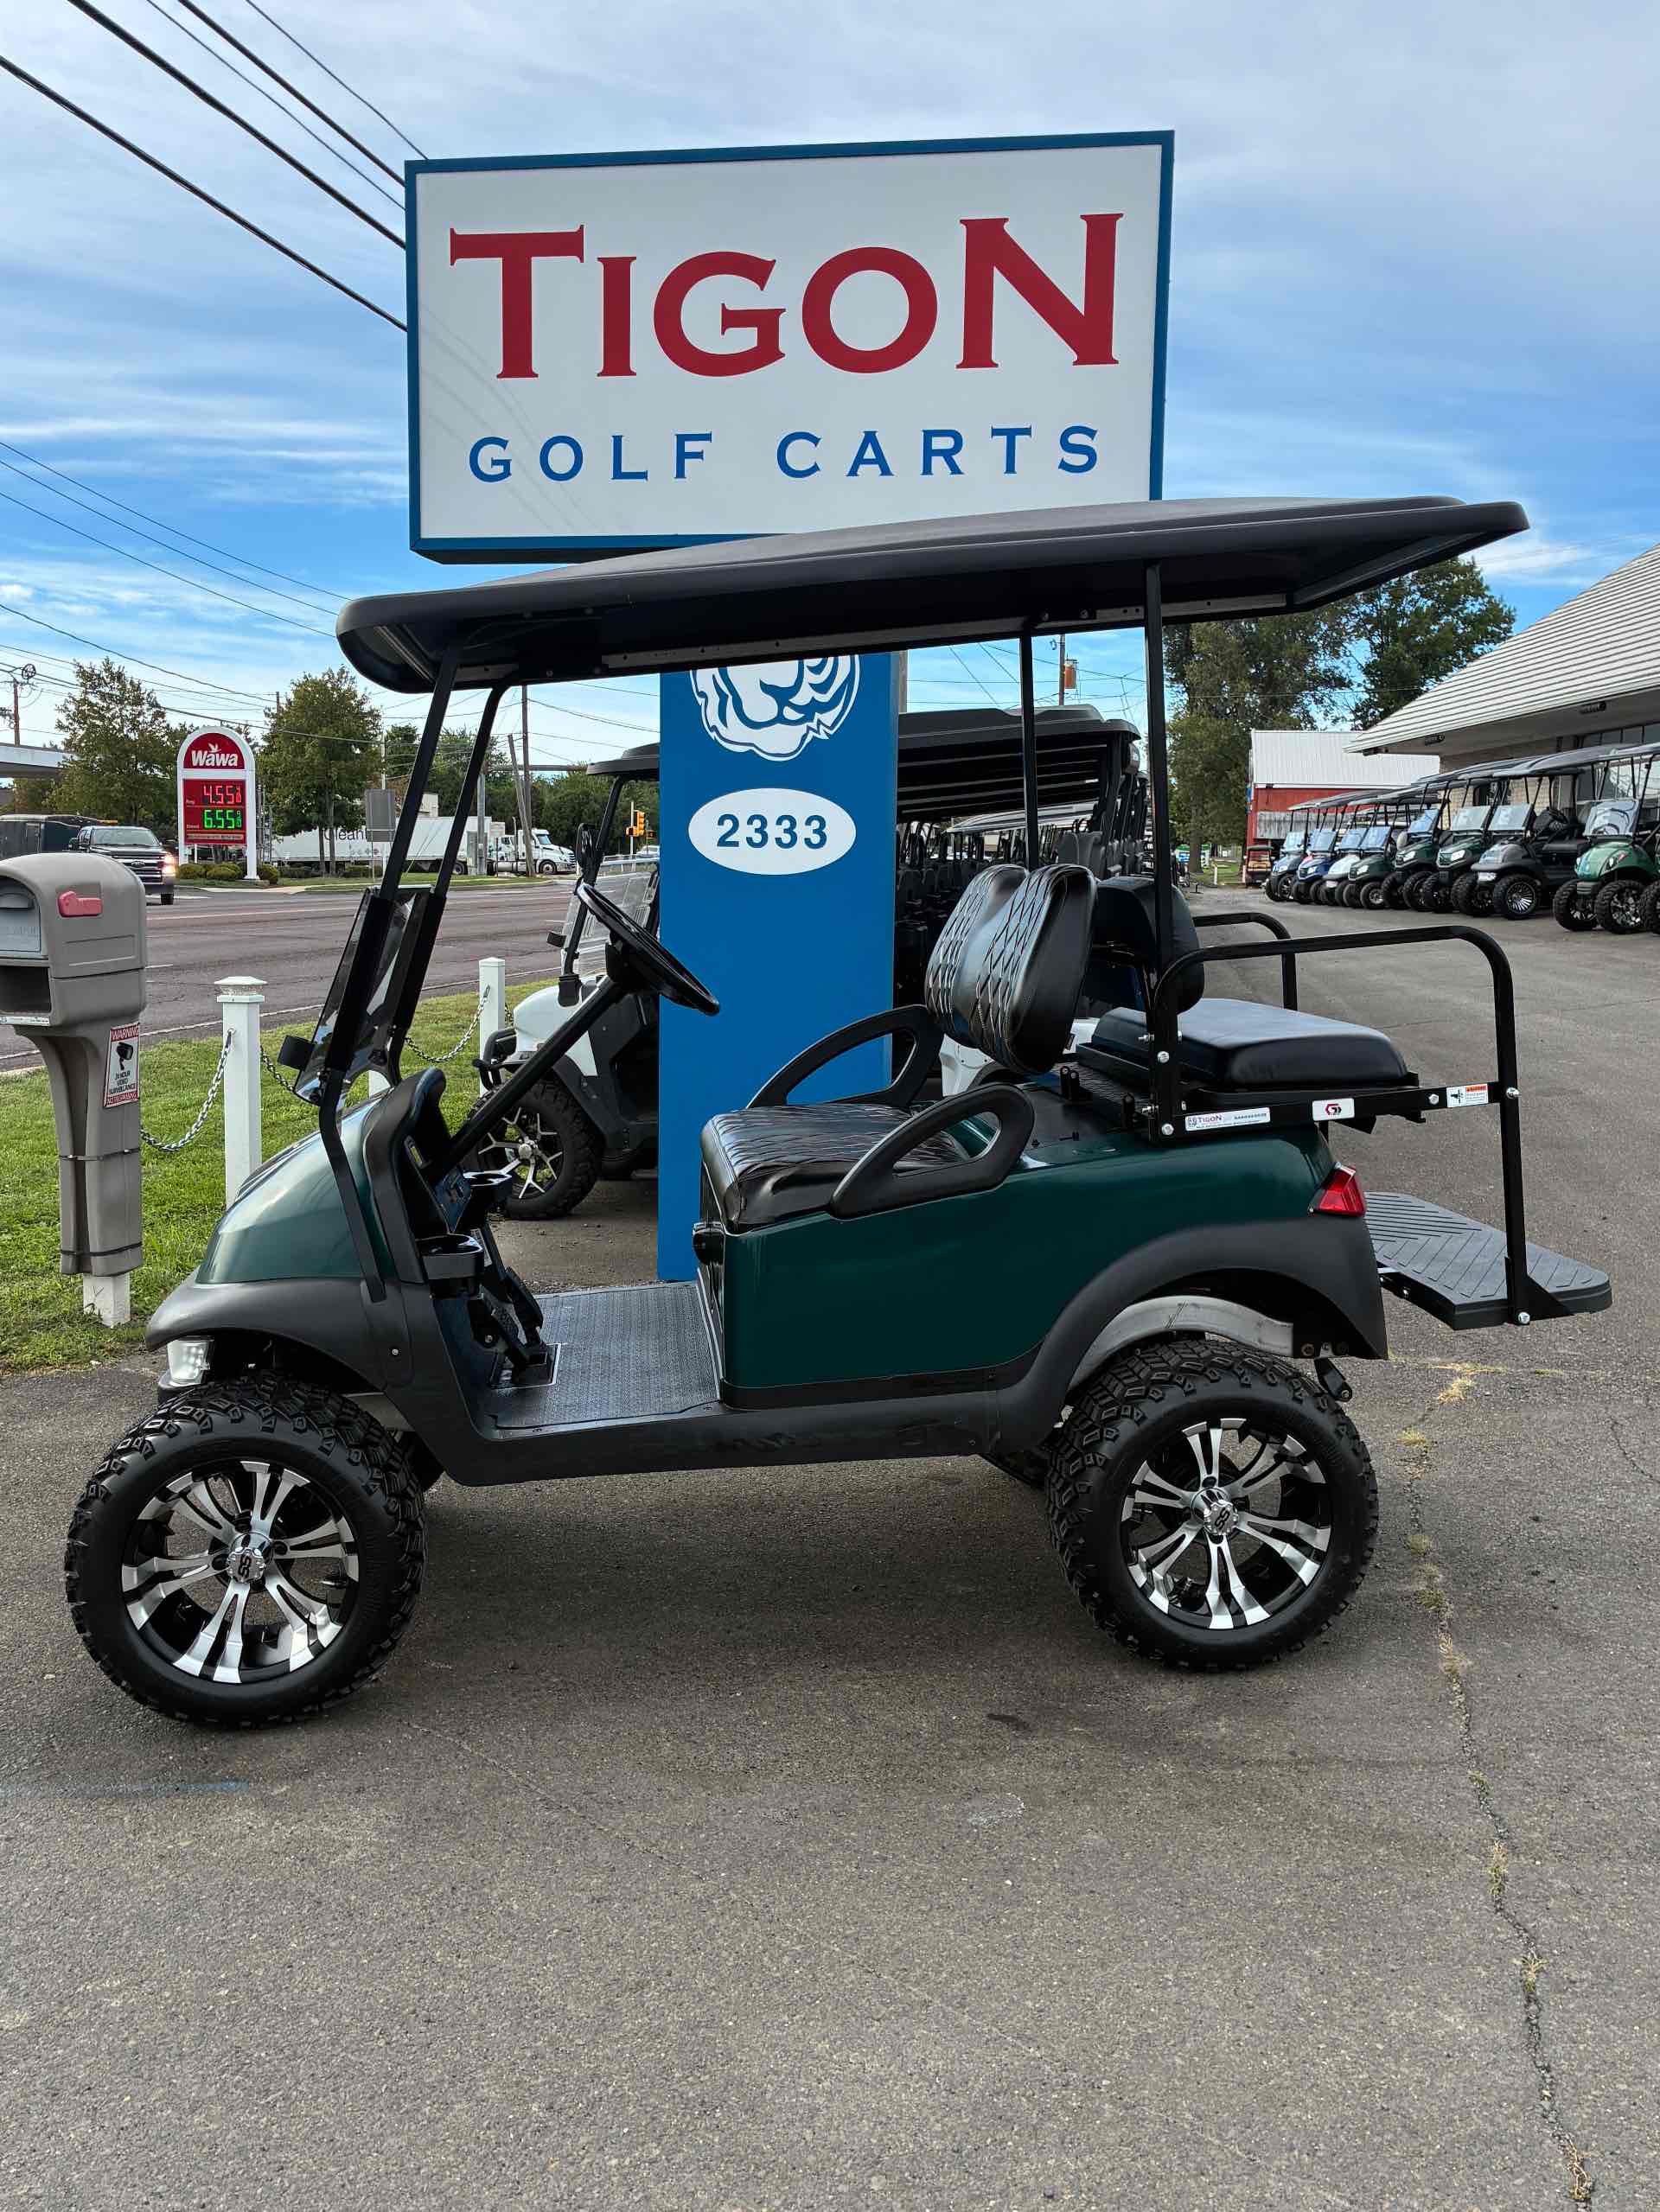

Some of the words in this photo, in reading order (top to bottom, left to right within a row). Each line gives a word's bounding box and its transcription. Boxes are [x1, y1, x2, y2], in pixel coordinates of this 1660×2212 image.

[450, 213, 1124, 378] TIGON
[469, 430, 713, 482] GOLF
[776, 424, 1098, 479] CARTS
[191, 749, 239, 767] Wawa
[717, 814, 827, 850] 2333
